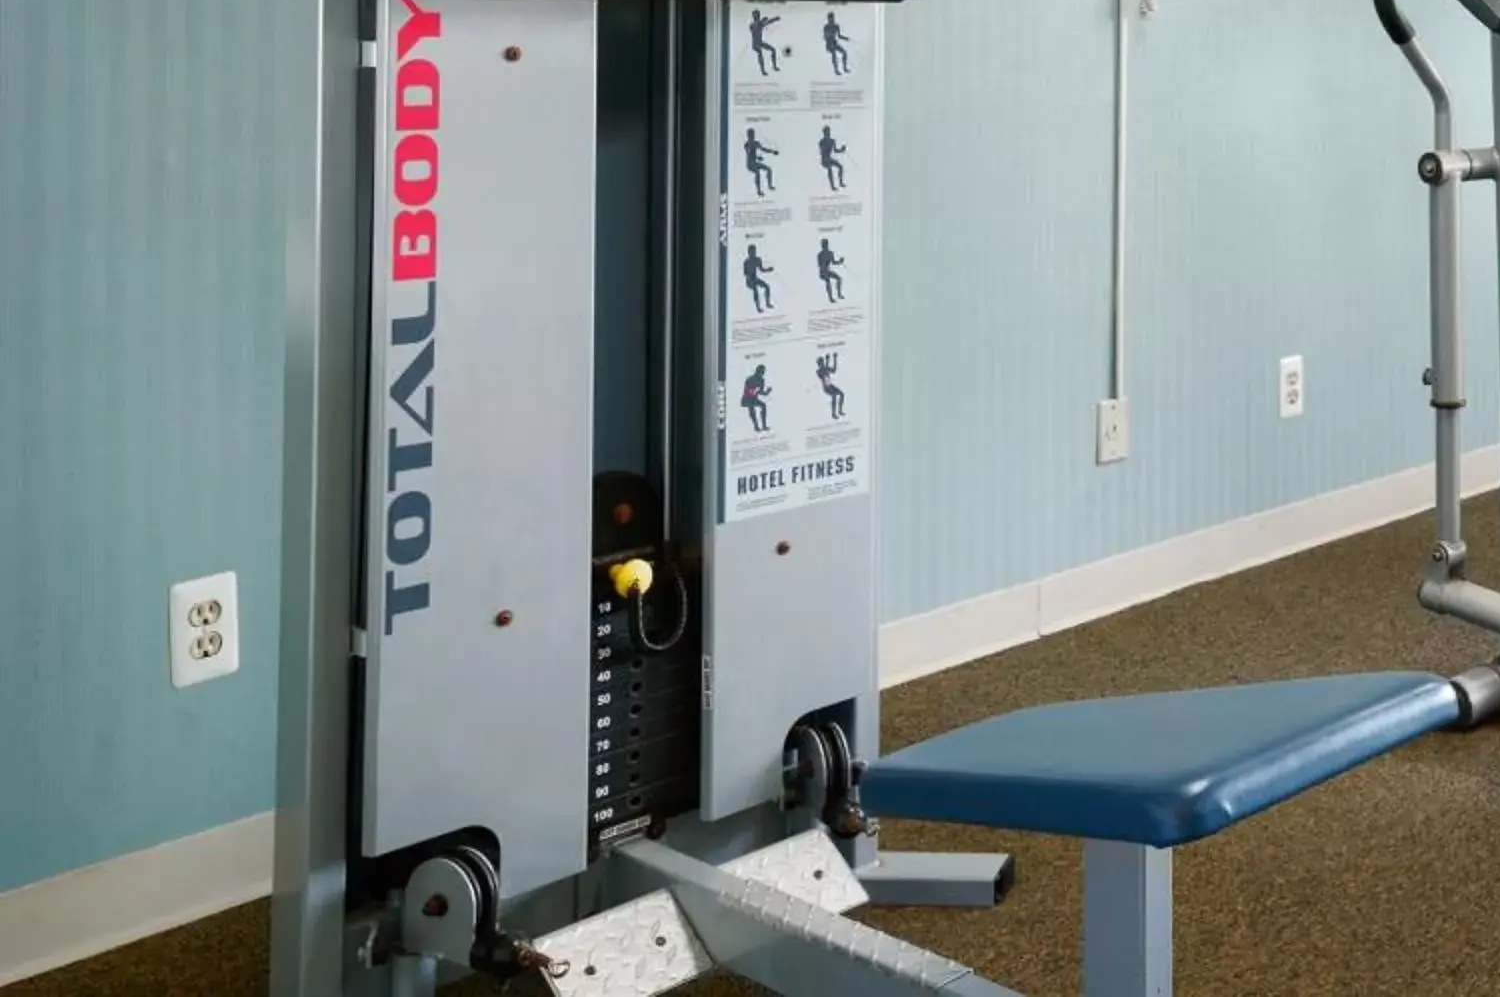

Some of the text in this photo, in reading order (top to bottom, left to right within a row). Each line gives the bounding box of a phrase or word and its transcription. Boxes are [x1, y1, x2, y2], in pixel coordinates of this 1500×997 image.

[737, 469, 785, 496] HOTEL
[791, 456, 855, 484] FITNESS
[597, 624, 611, 637] 20
[597, 670, 611, 682] 40
[597, 716, 611, 729] 60
[594, 807, 613, 823] 100
